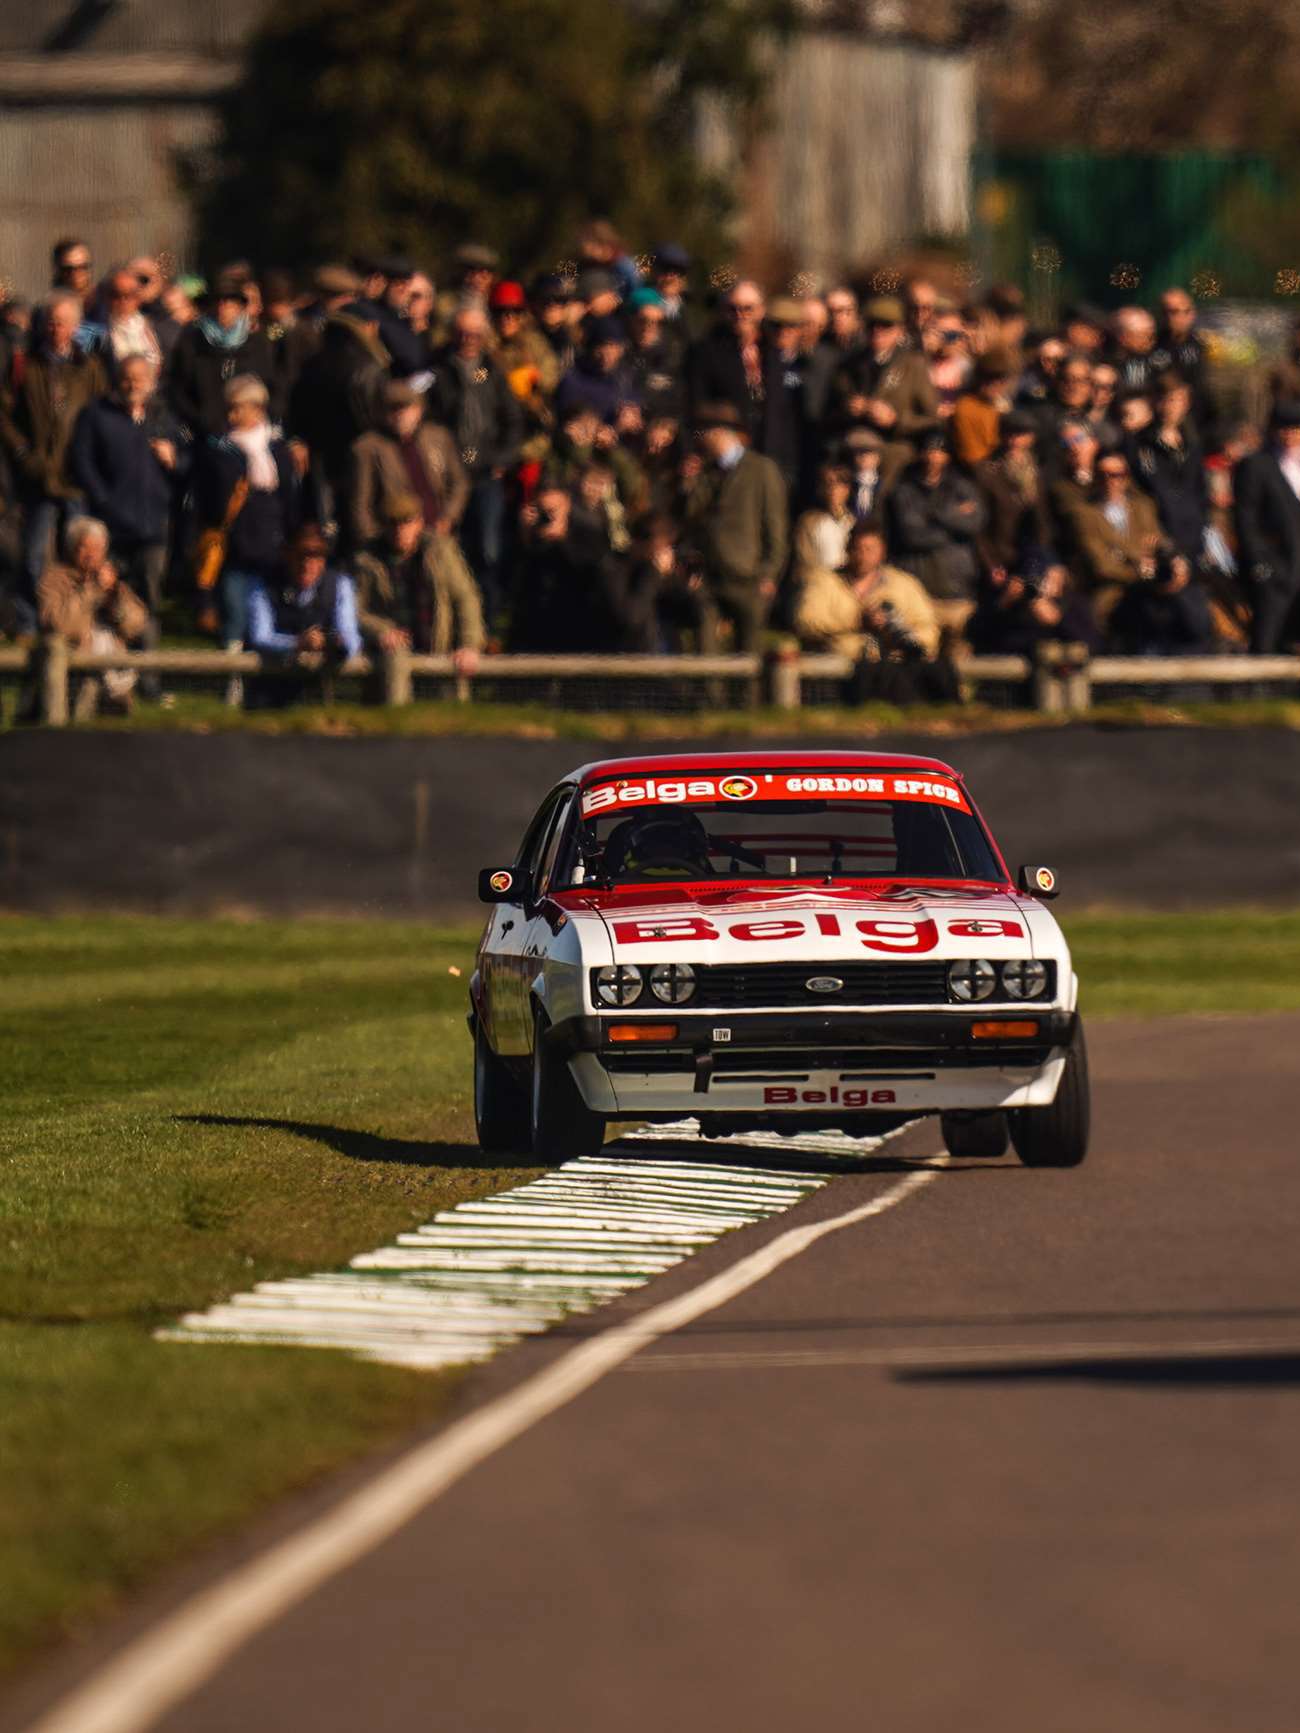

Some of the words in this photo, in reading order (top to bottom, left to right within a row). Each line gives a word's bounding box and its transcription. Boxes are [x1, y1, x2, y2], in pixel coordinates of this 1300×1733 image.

[582, 780, 716, 814] Belga
[786, 778, 885, 792] GORDON
[893, 780, 961, 803] SPICE
[612, 913, 1025, 954] Belga
[714, 1030, 730, 1041] TOW
[764, 1086, 897, 1107] Belga
